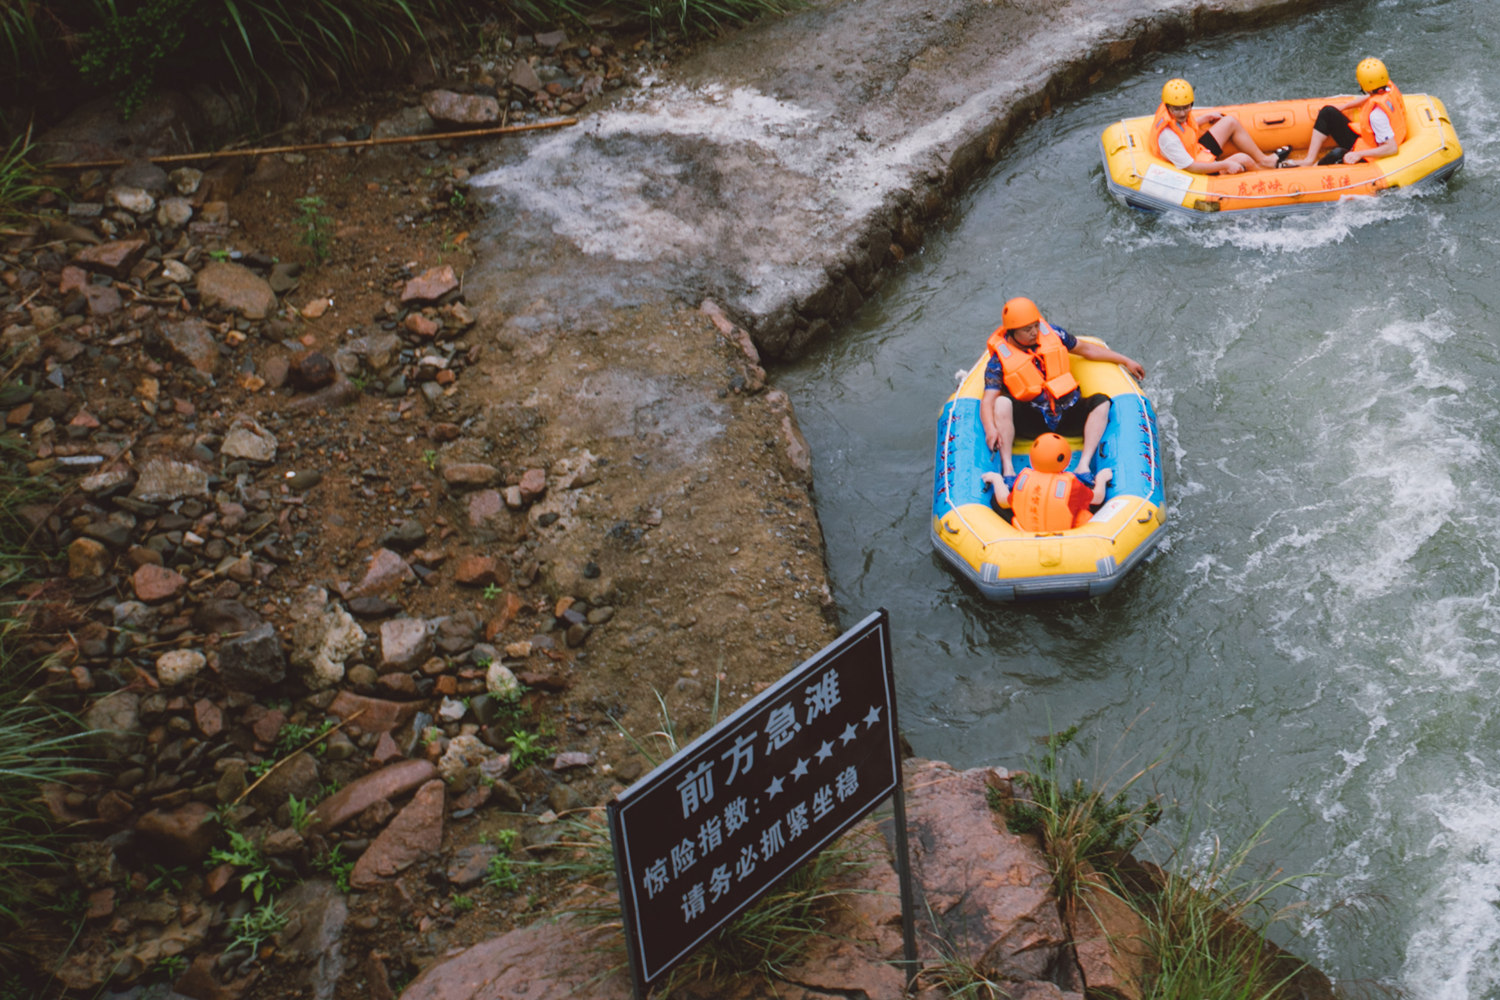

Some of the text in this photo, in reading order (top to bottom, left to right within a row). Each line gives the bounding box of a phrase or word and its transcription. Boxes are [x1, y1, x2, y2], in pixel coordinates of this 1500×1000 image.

[676, 667, 842, 820] 前方急滩
[680, 764, 860, 924] 请务必抓紧坐稳
